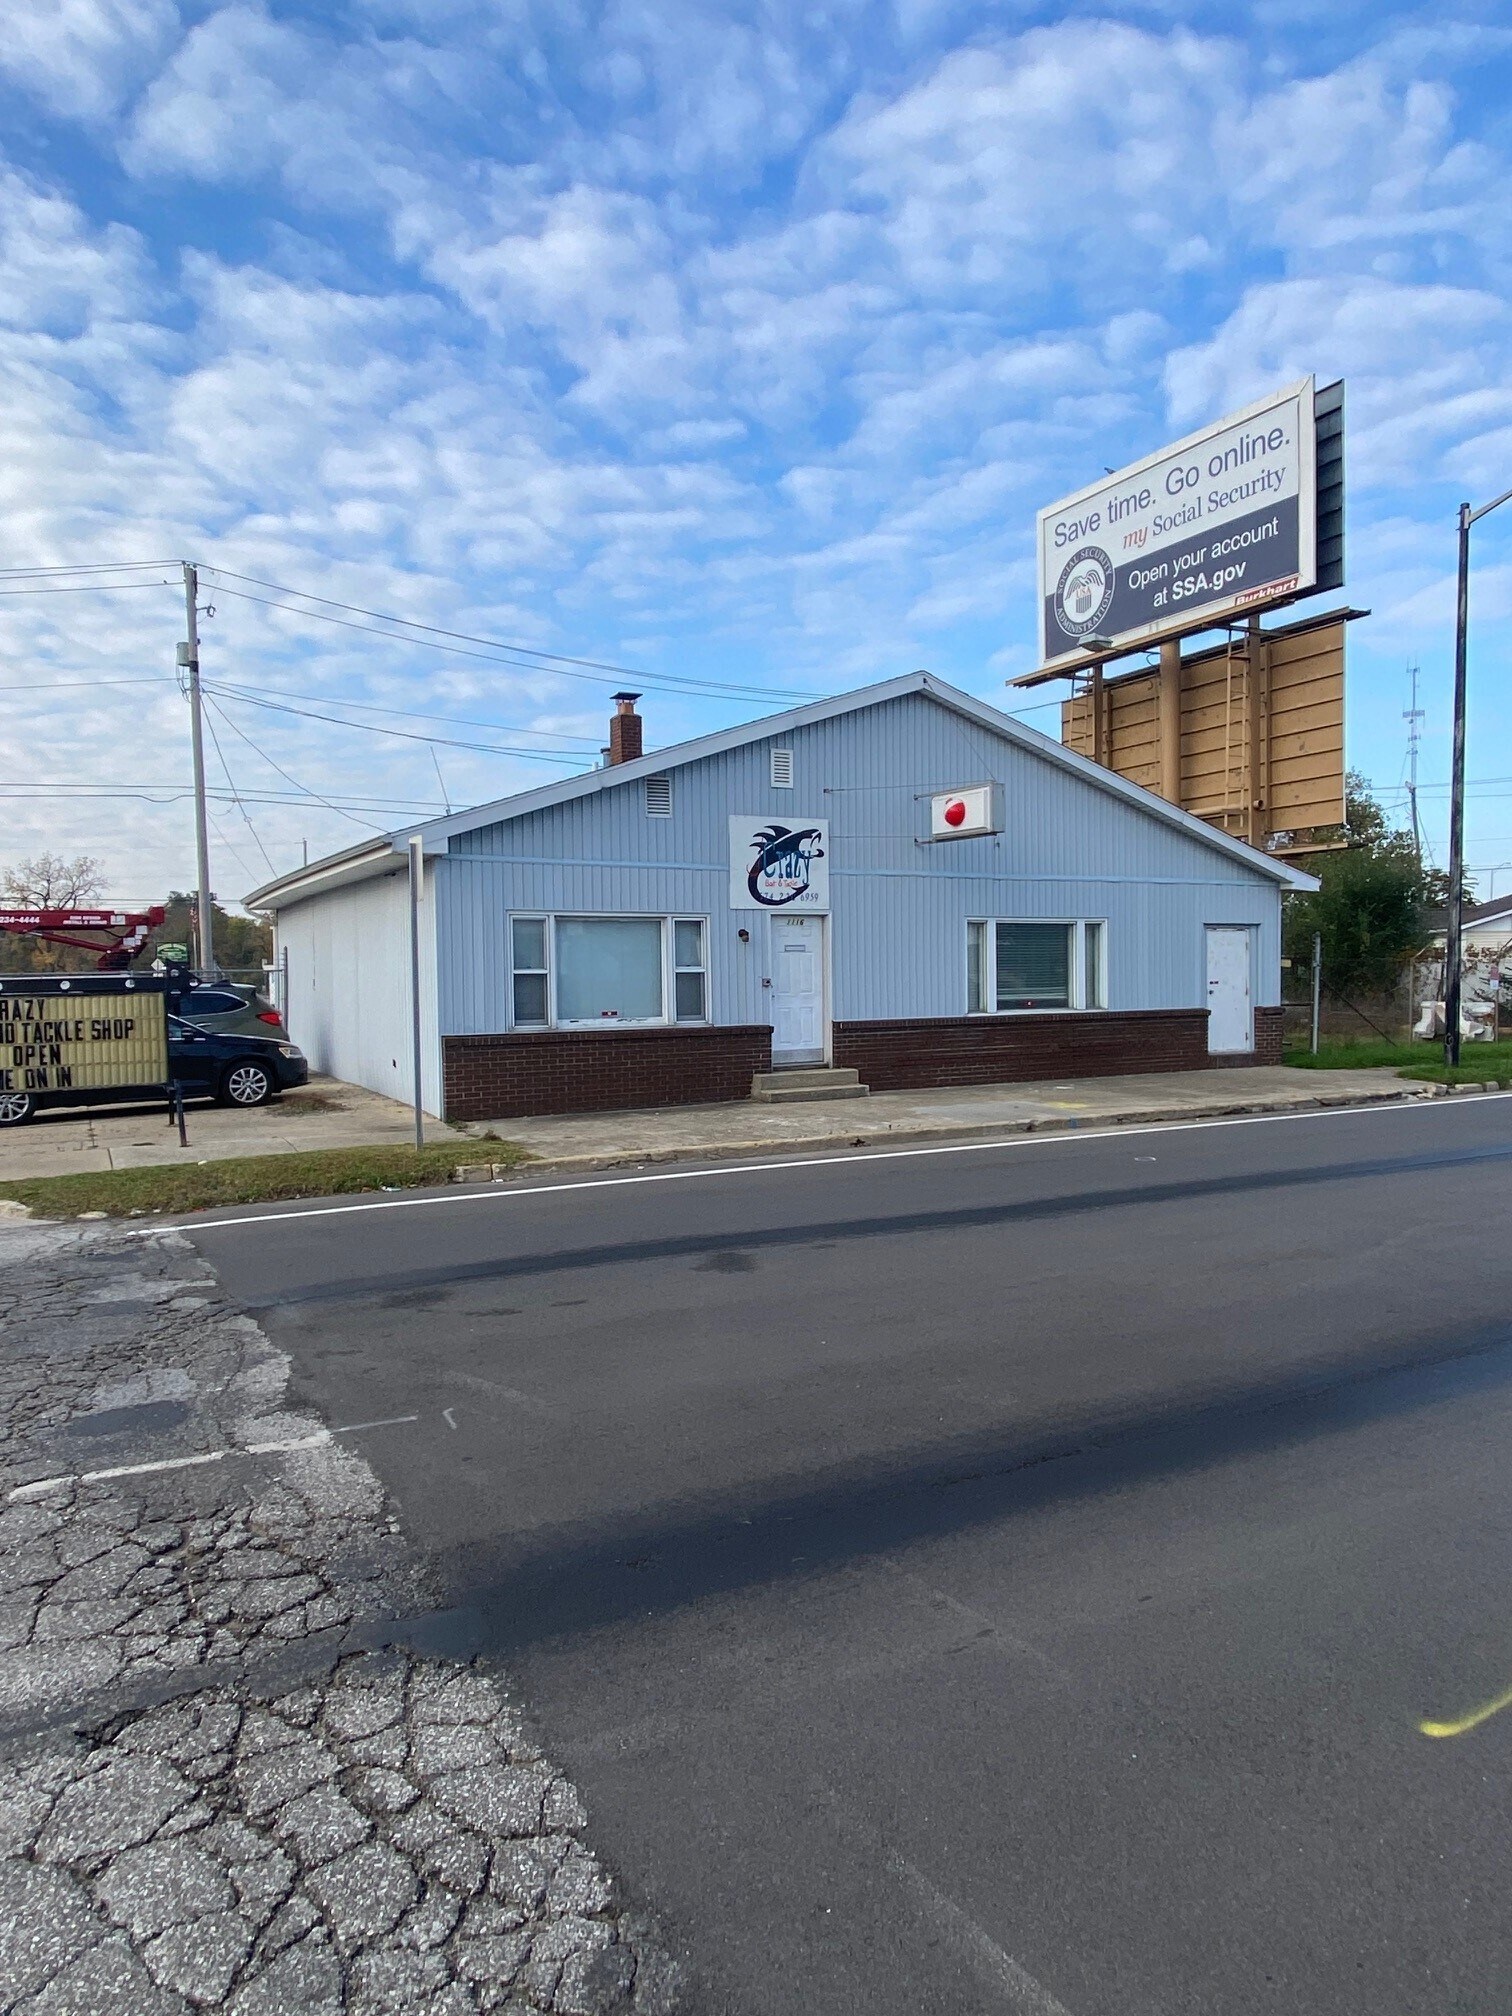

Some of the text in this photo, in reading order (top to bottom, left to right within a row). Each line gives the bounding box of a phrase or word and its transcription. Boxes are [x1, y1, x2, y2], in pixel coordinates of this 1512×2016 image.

[1054, 427, 1290, 548] Save time. Go online.
[1123, 466, 1286, 550] my Social Security
[1057, 547, 1112, 594] SOCIAL SECURITY
[1128, 516, 1280, 590] Open your account
[1153, 561, 1247, 607] at SSA.gov
[1236, 579, 1297, 606] Burkhart
[1057, 589, 1113, 634] ADMINISTRATION
[786, 918, 805, 926] 1116
[22, 1020, 84, 1044] TACKLE
[91, 1019, 134, 1040] SHOP
[13, 1044, 61, 1067] OPEN
[25, 1067, 48, 1089] ON
[56, 1066, 72, 1088] IN
